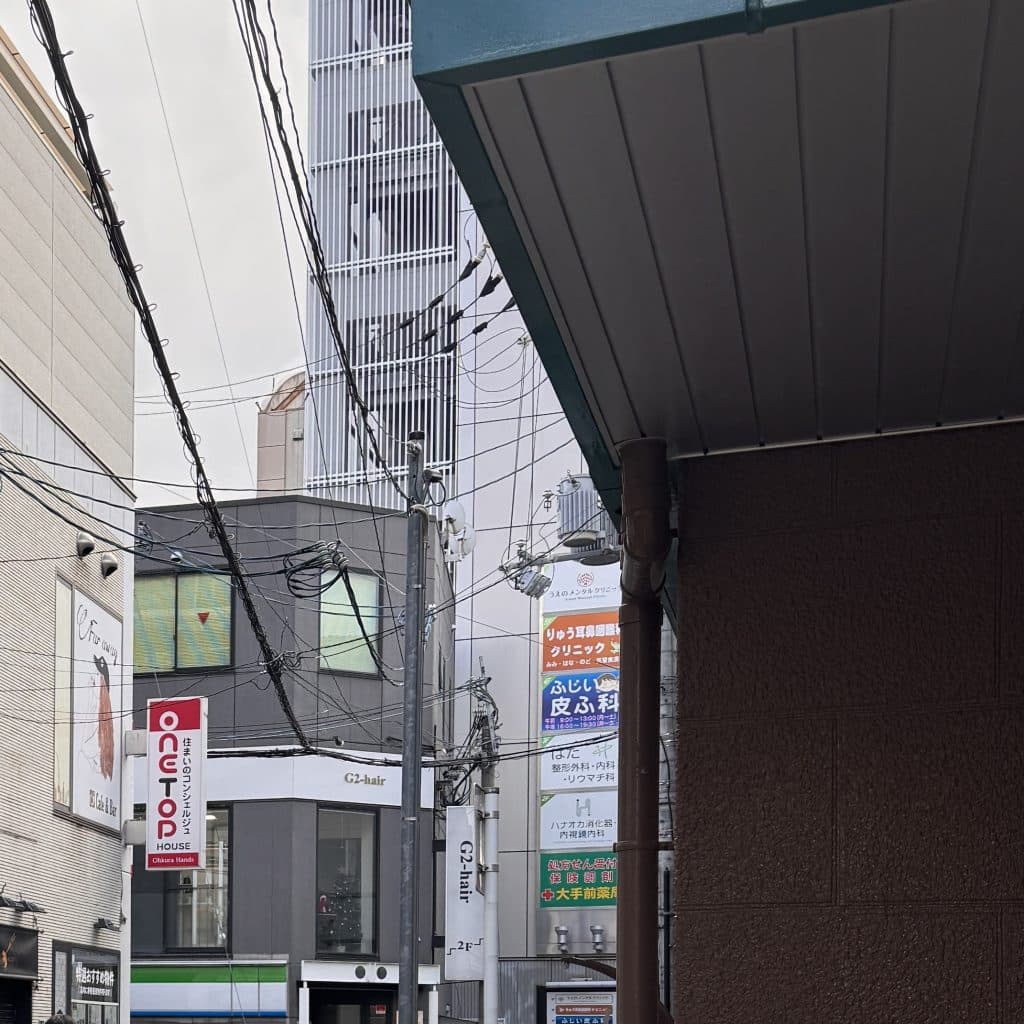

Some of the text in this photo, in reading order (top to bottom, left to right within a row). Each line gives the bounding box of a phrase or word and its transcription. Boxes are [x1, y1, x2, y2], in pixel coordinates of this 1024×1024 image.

[551, 642, 605, 657] クリニック
[550, 679, 600, 694] ふじい
[550, 693, 619, 717] 皮ふ科
[182, 737, 192, 835] 住まいのコンシェルジュ
[344, 772, 386, 786] G2-hair
[559, 829, 605, 839] 内視鏡内科
[156, 842, 191, 851] HOUSE
[459, 840, 474, 904] G2-hair
[457, 940, 473, 952] 2F
